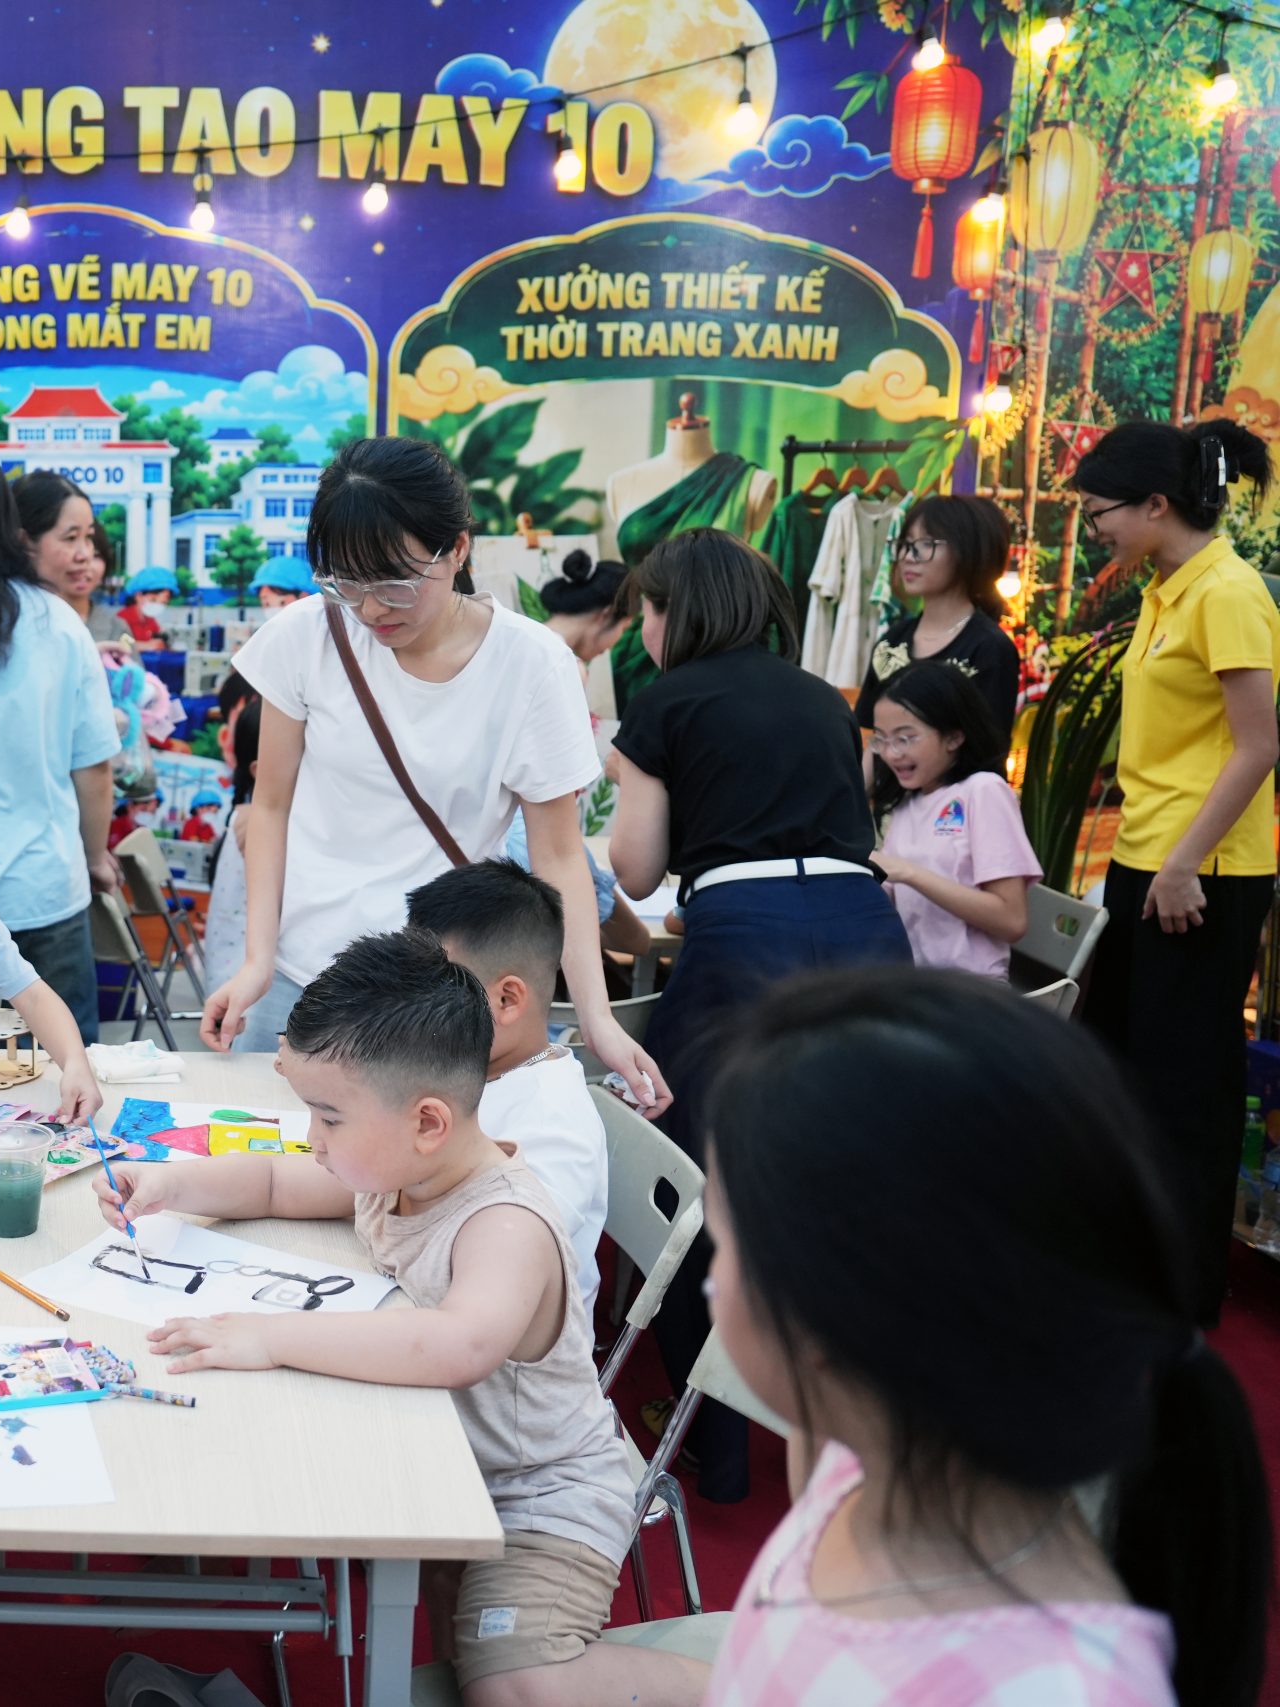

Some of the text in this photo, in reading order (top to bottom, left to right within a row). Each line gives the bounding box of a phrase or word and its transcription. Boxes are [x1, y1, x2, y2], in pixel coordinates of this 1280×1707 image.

[318, 89, 529, 187] MAY
[546, 101, 654, 196] 10
[111, 262, 199, 303] MAY
[207, 267, 254, 308] 10
[516, 260, 831, 315] XƯỞNG THIẾT KẾ
[67, 302, 146, 348] MẮT
[155, 313, 213, 352] EM
[500, 315, 839, 362] THỜI TRANG XANH
[33, 467, 124, 483] RCO 10
